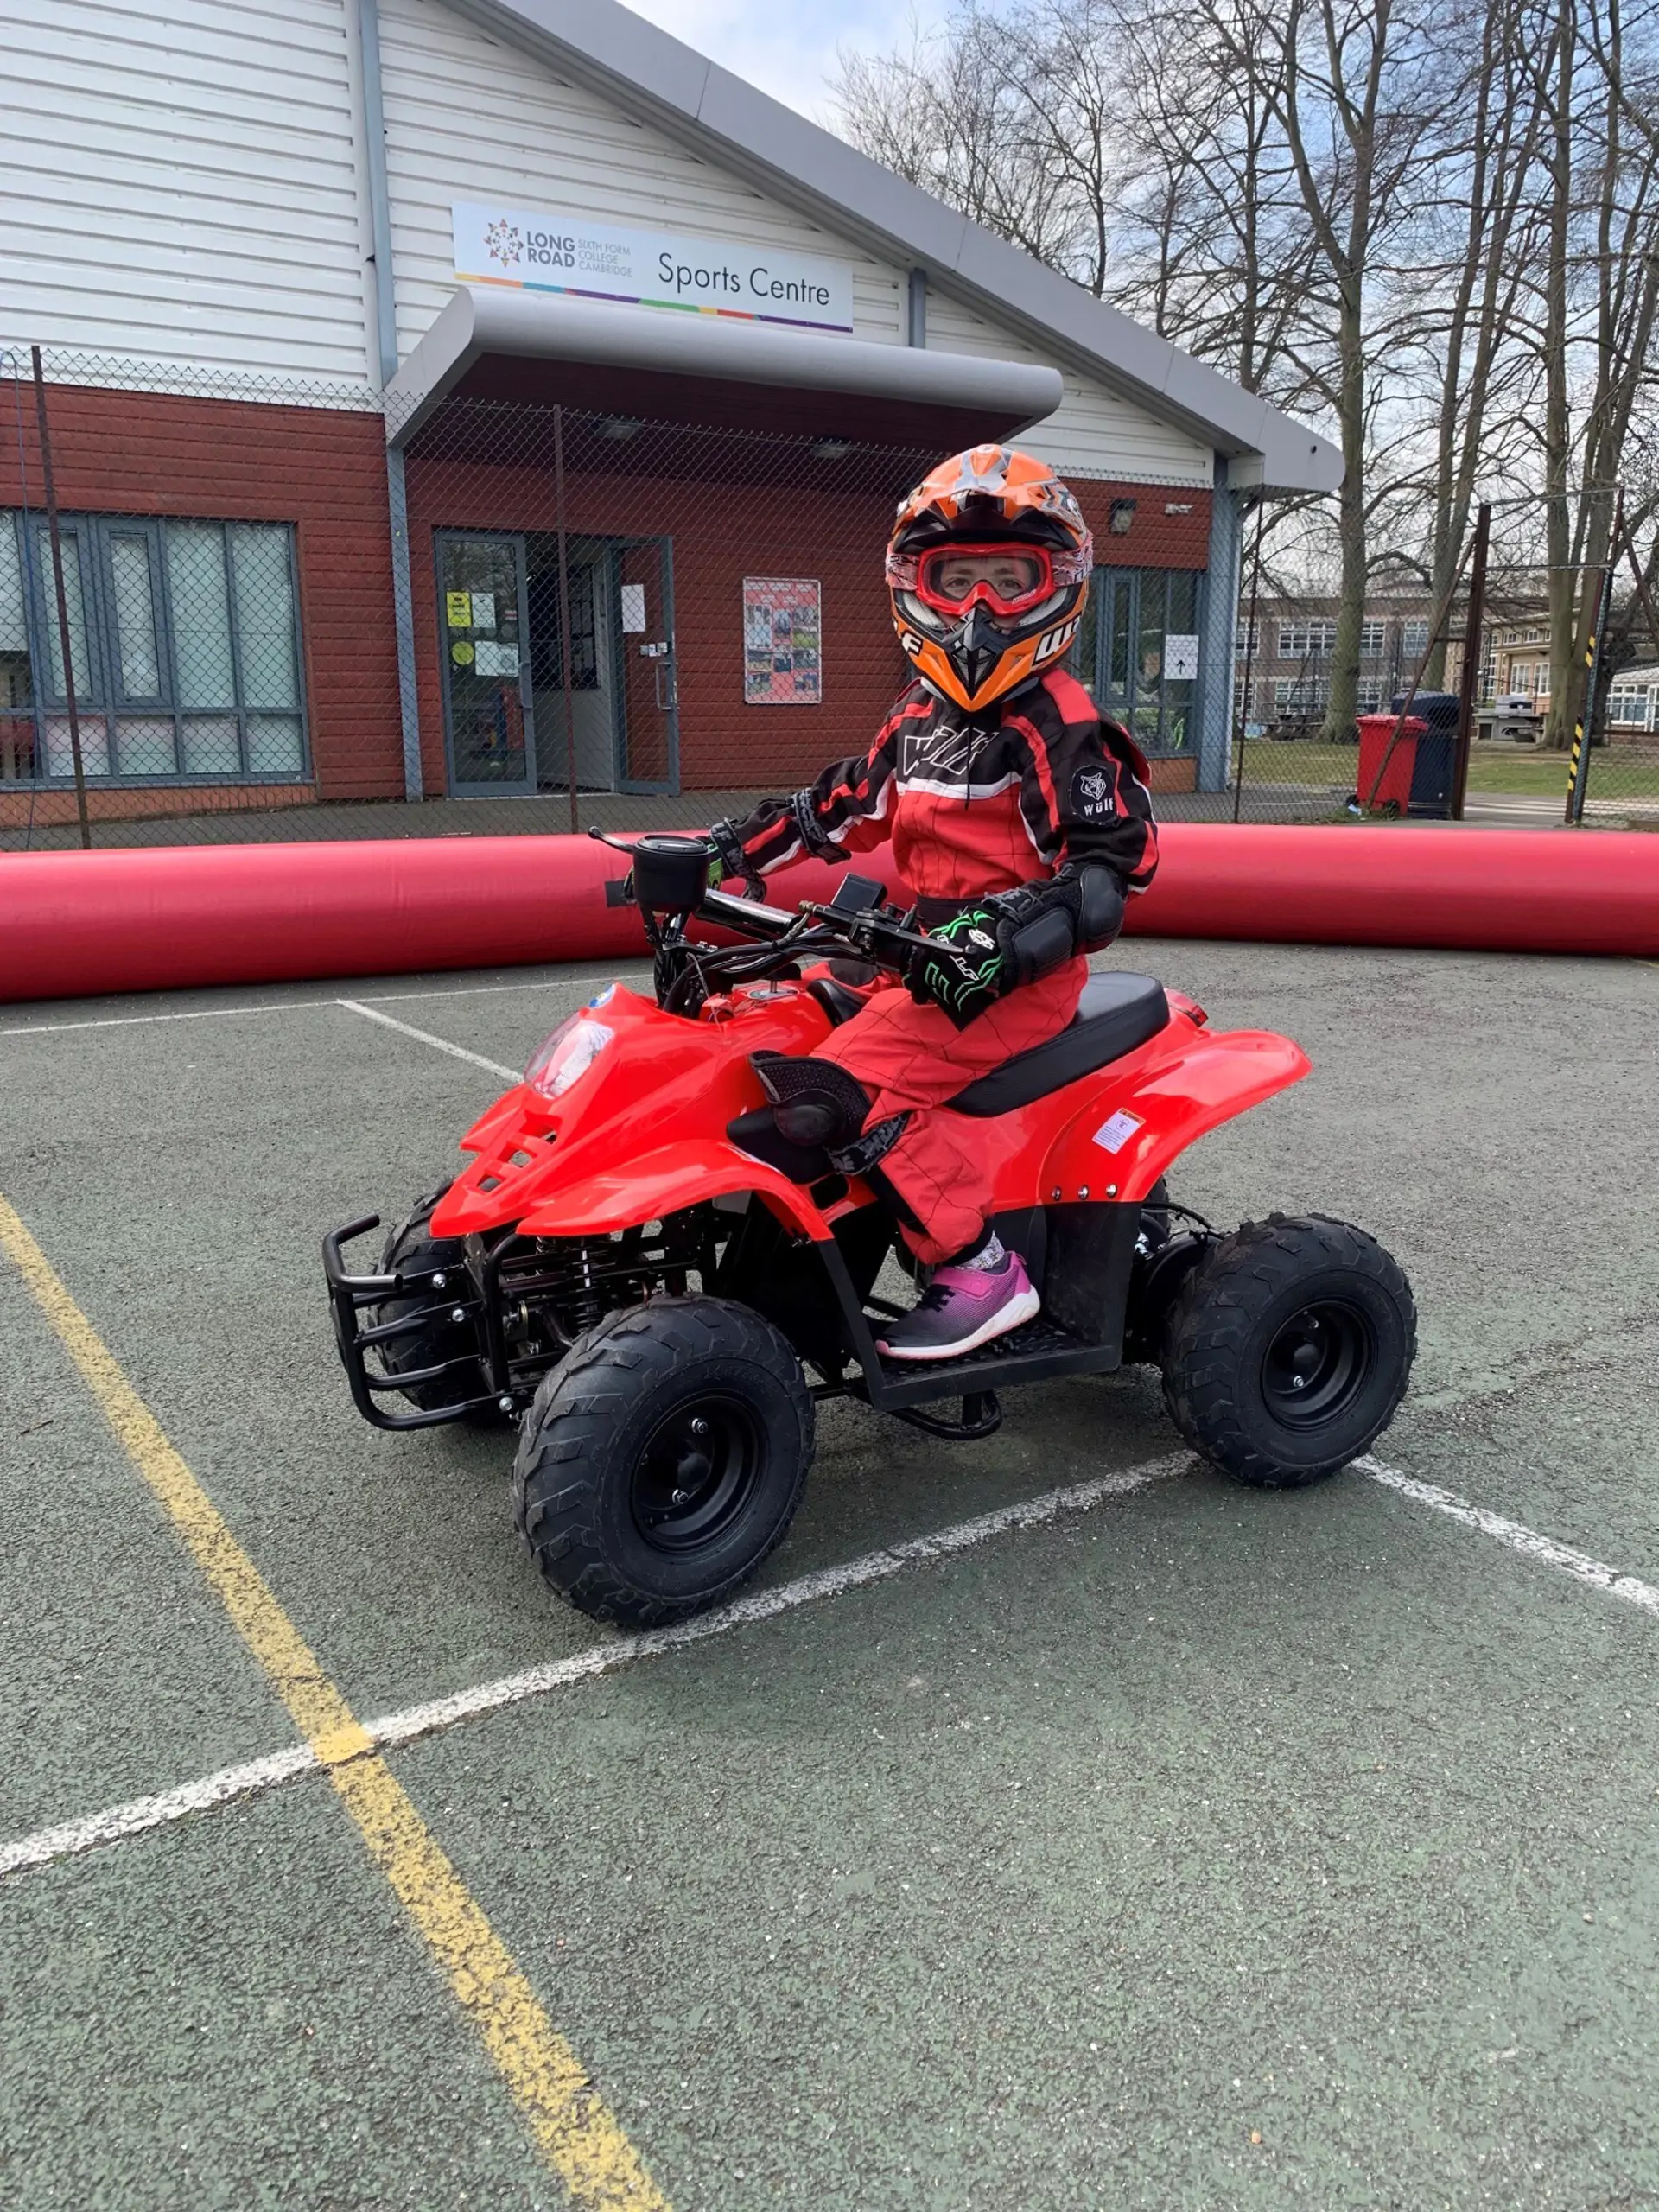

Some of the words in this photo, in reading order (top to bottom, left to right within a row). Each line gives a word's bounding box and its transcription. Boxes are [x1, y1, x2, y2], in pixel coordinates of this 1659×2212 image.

[526, 231, 575, 252] LONG
[578, 238, 603, 251] SIXTH
[605, 243, 631, 256] FORM
[527, 247, 575, 268] ROAD
[578, 250, 619, 264] COLLEGE
[578, 260, 632, 277] CAMBRIDGE
[658, 252, 741, 294] Sports
[749, 267, 830, 305] Centre
